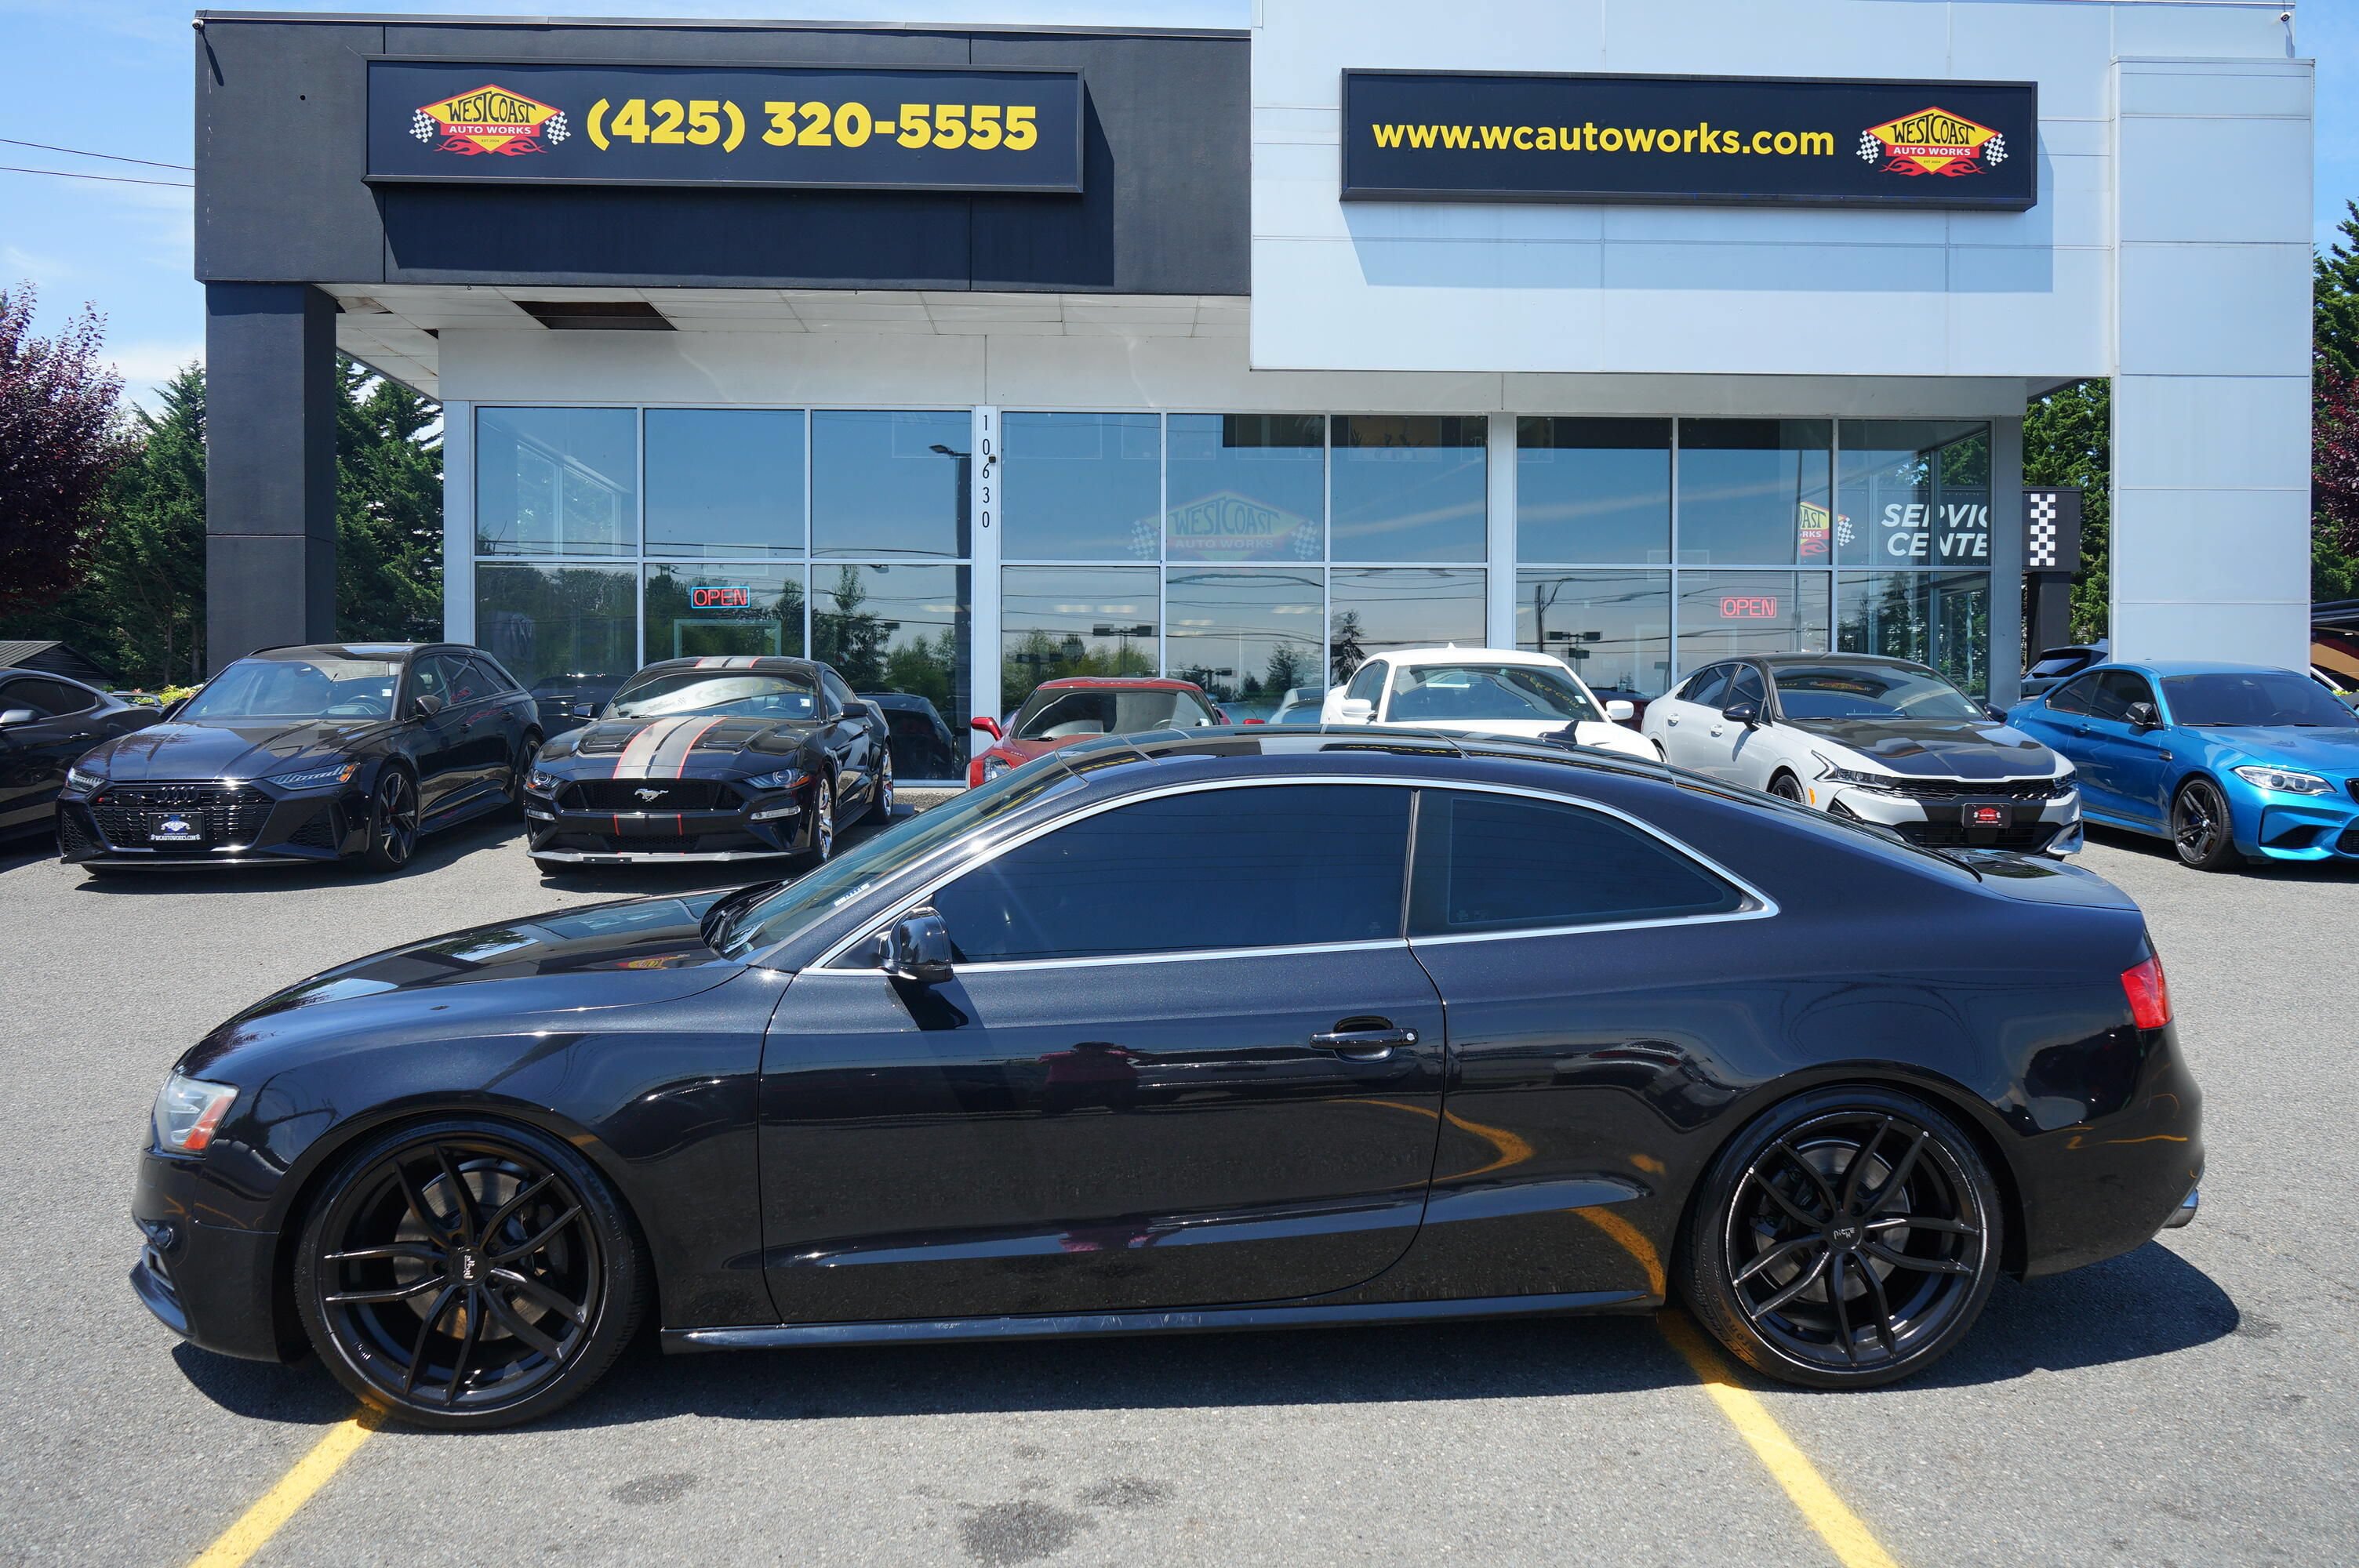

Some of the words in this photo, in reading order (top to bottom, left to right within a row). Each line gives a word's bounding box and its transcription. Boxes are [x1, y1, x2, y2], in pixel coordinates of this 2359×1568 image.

[449, 125, 483, 134] AUTO
[587, 99, 745, 153] (425)
[761, 101, 1038, 151] 320-5555
[1372, 122, 1834, 156] www.wcautoworks.com
[1176, 539, 1216, 548] AUTO
[1219, 539, 1274, 548] WORKS
[693, 589, 747, 606] OPEN
[1723, 599, 1774, 616] OPEN
